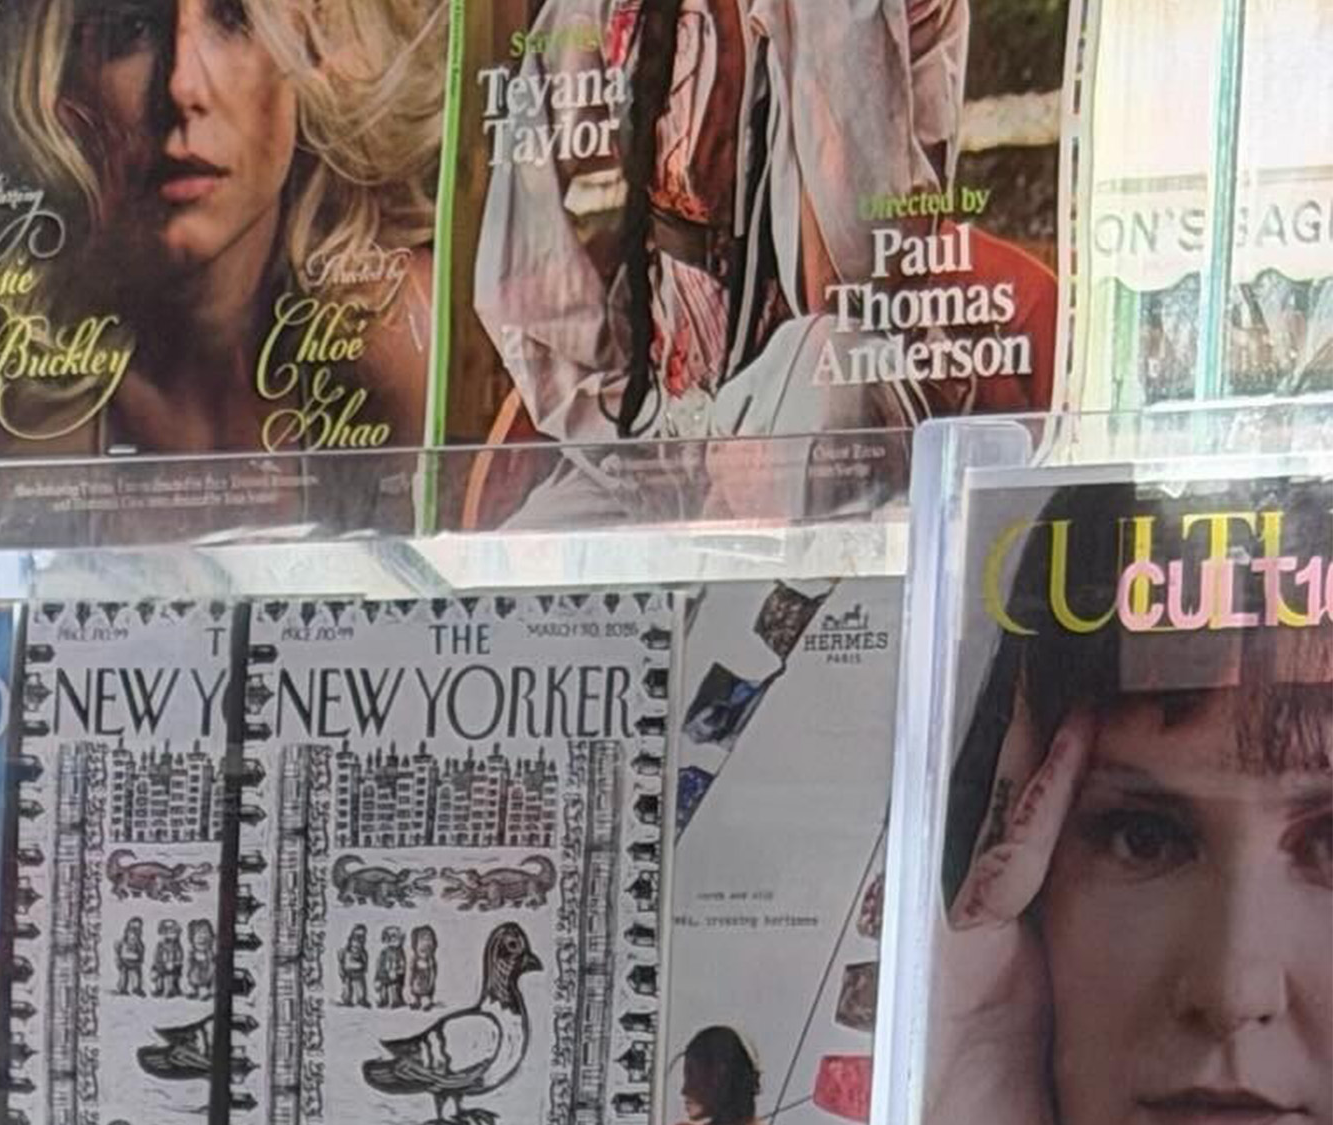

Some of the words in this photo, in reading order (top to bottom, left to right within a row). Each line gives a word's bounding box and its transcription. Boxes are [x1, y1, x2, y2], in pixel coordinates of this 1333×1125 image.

[477, 66, 627, 118] Teyana
[484, 117, 620, 167] Taylor
[859, 193, 955, 221] Directed
[962, 186, 991, 219] by
[870, 222, 973, 279] Paul
[824, 283, 1016, 335] Thomas
[811, 333, 1033, 387] Anderson
[428, 623, 493, 656] THE
[825, 652, 863, 665] PARIS
[52, 667, 182, 739] NEW
[275, 665, 409, 740] NEW
[412, 663, 635, 741] YORKER
